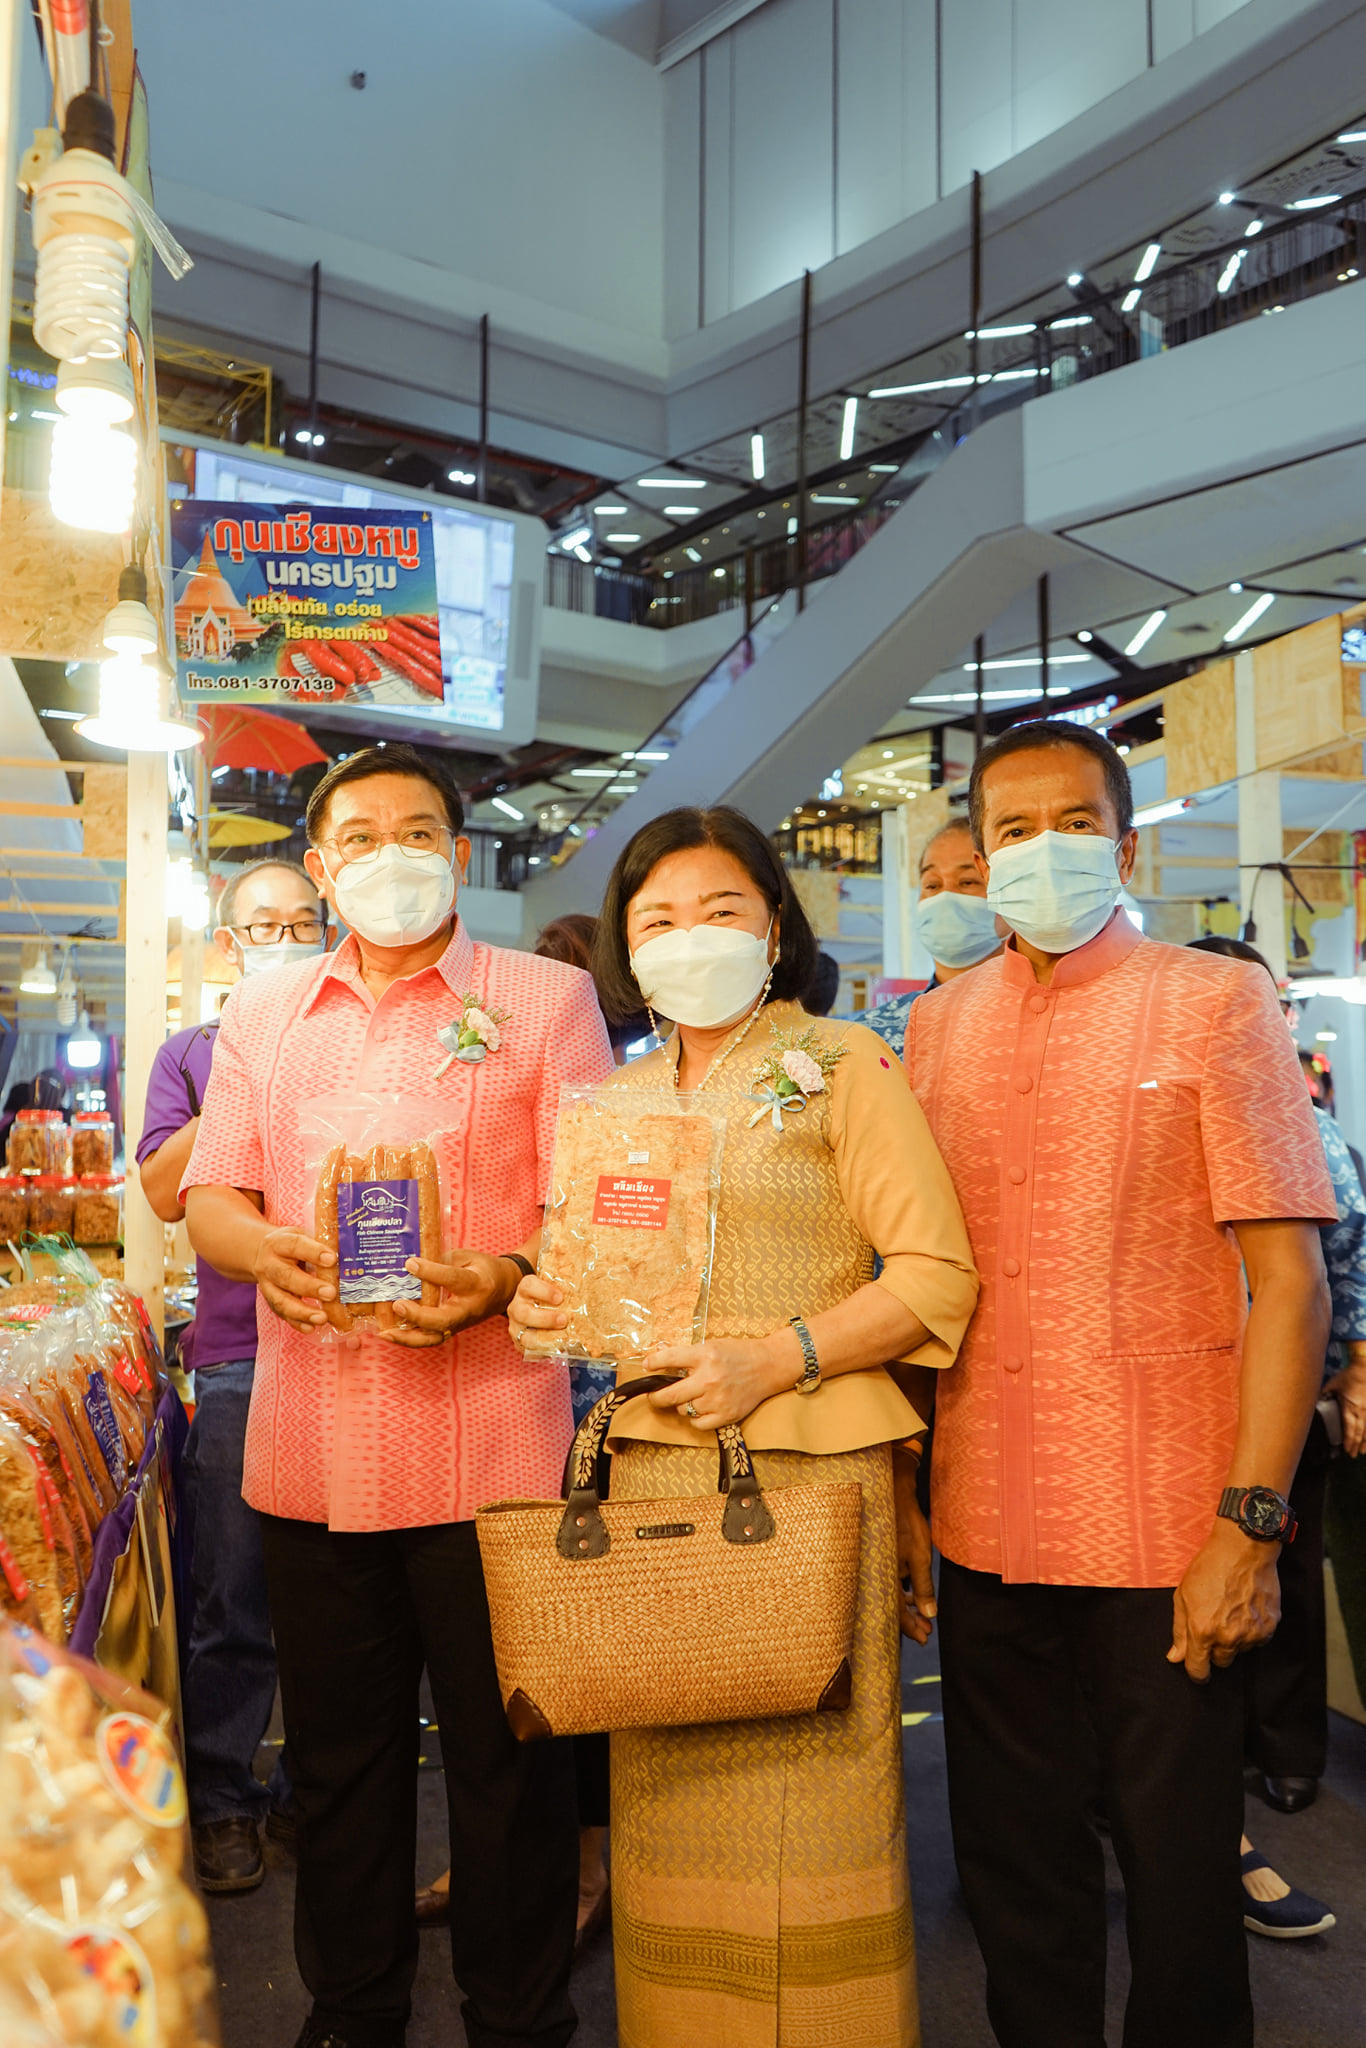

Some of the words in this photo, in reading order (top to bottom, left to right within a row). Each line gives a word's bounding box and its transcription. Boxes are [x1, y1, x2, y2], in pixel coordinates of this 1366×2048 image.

[213, 511, 421, 570] กุนเชียงหมู
[266, 560, 398, 597] นครปฐม
[254, 597, 328, 617] ปลอดภัย
[334, 601, 383, 618] อร่อย
[282, 619, 388, 643] ไร้สารตกค้าง
[186, 671, 336, 693] โทร.081-3707138
